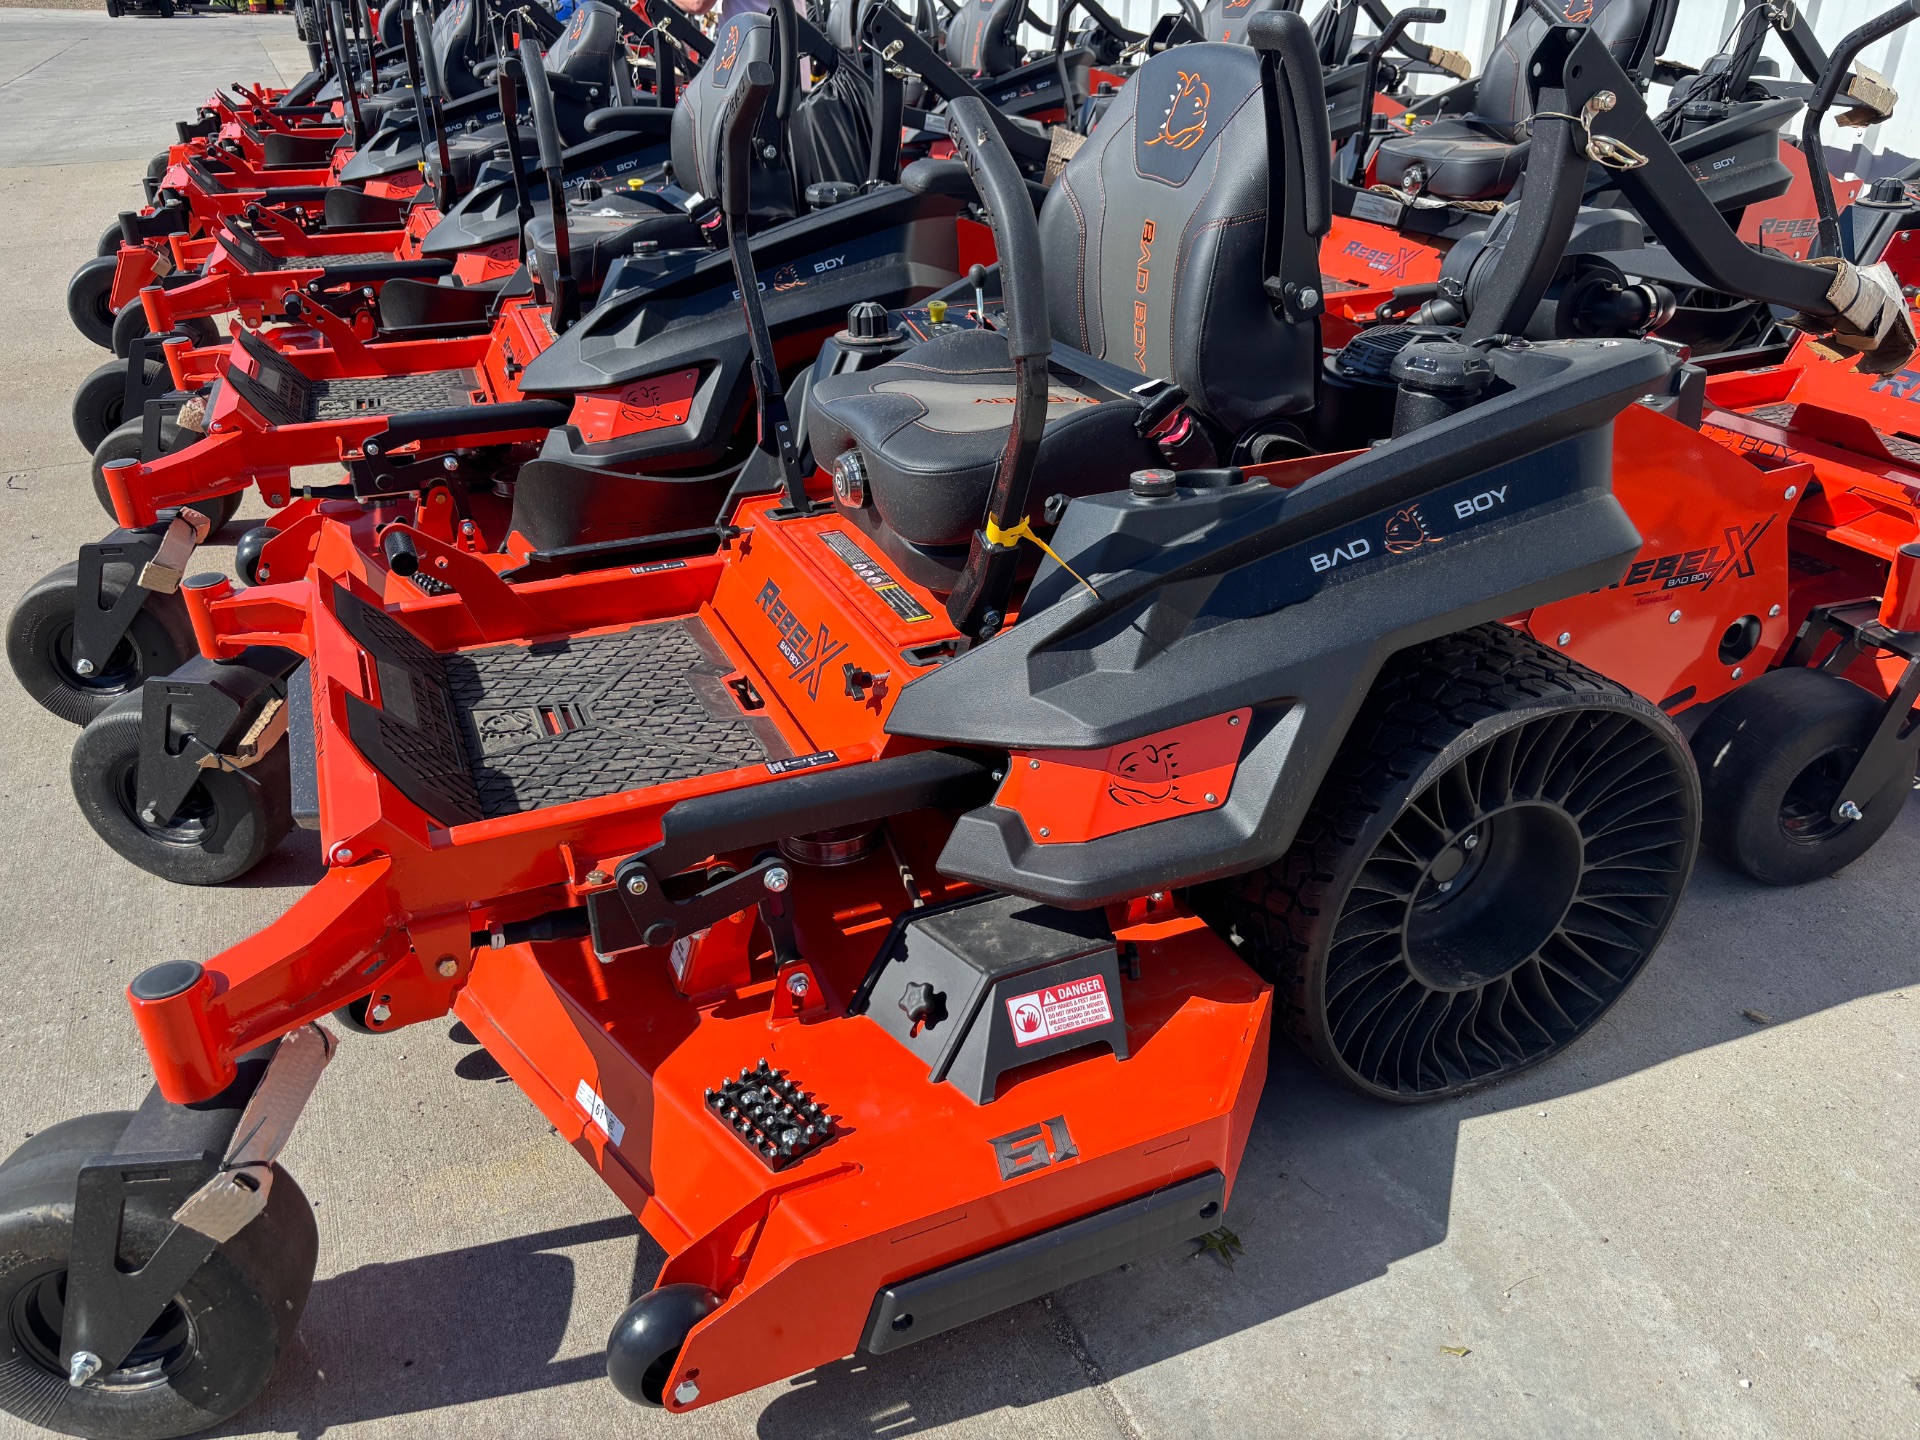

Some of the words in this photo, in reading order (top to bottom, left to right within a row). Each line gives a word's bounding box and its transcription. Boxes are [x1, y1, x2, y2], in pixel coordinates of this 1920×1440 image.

[444, 123, 463, 133] BAD
[486, 111, 503, 121] BOY
[616, 159, 638, 172] BOY
[1713, 155, 1736, 170] BOY
[813, 255, 846, 274] BOY
[1136, 218, 1156, 294] BAD
[1133, 301, 1147, 374] BOY
[1739, 435, 1800, 462] BOY
[1309, 538, 1371, 573] BAD
[1453, 485, 1508, 520] BOY
[1667, 576, 1689, 587] BAD
[1690, 571, 1712, 583] BOY
[1637, 592, 1674, 606] Kawasaki
[779, 641, 790, 656] BAD
[789, 651, 801, 668] BOY
[1580, 694, 1596, 703] NOT
[1598, 694, 1613, 703] FOR
[1614, 696, 1643, 711] HIGHWAY
[1645, 706, 1657, 717] USE
[1057, 979, 1101, 1000] DANGER
[1045, 1005, 1056, 1014] KEEP
[1057, 1001, 1073, 1010] HANDS
[1078, 996, 1089, 1005] FEET
[1056, 1010, 1065, 1018] NOT
[1065, 1005, 1086, 1014] OPERATE
[1086, 1000, 1104, 1010] MOWER
[1049, 1017, 1067, 1026] UNLESS
[1067, 1012, 1083, 1022] GUARD
[1091, 1006, 1107, 1015] GRASS
[1054, 1021, 1075, 1031] CATCHER
[986, 1114, 1080, 1182] 61
